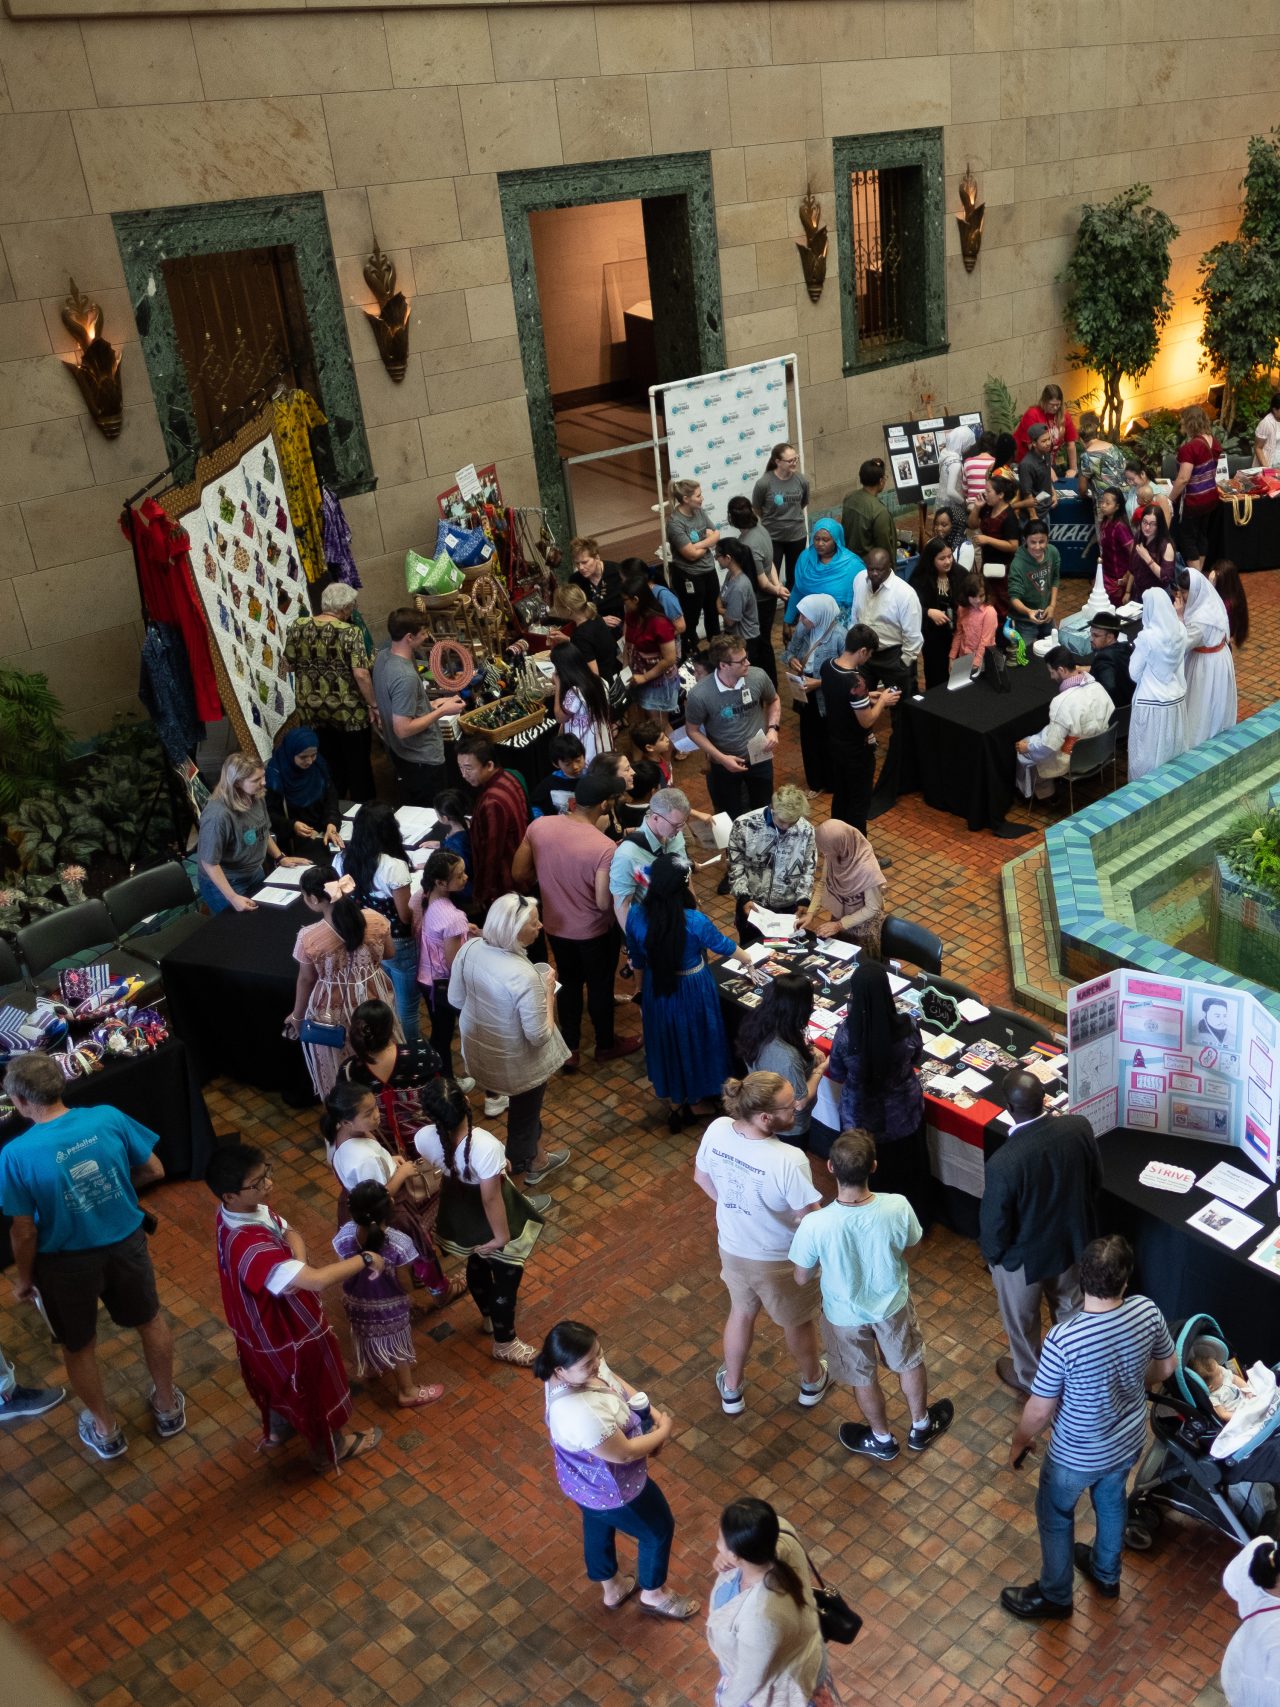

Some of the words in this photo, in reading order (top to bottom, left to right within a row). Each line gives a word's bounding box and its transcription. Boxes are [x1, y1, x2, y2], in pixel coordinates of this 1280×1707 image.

[1076, 977, 1111, 1000] KARENNI
[67, 1135, 98, 1155] pedalfest
[1148, 1165, 1192, 1183] STRIVE
